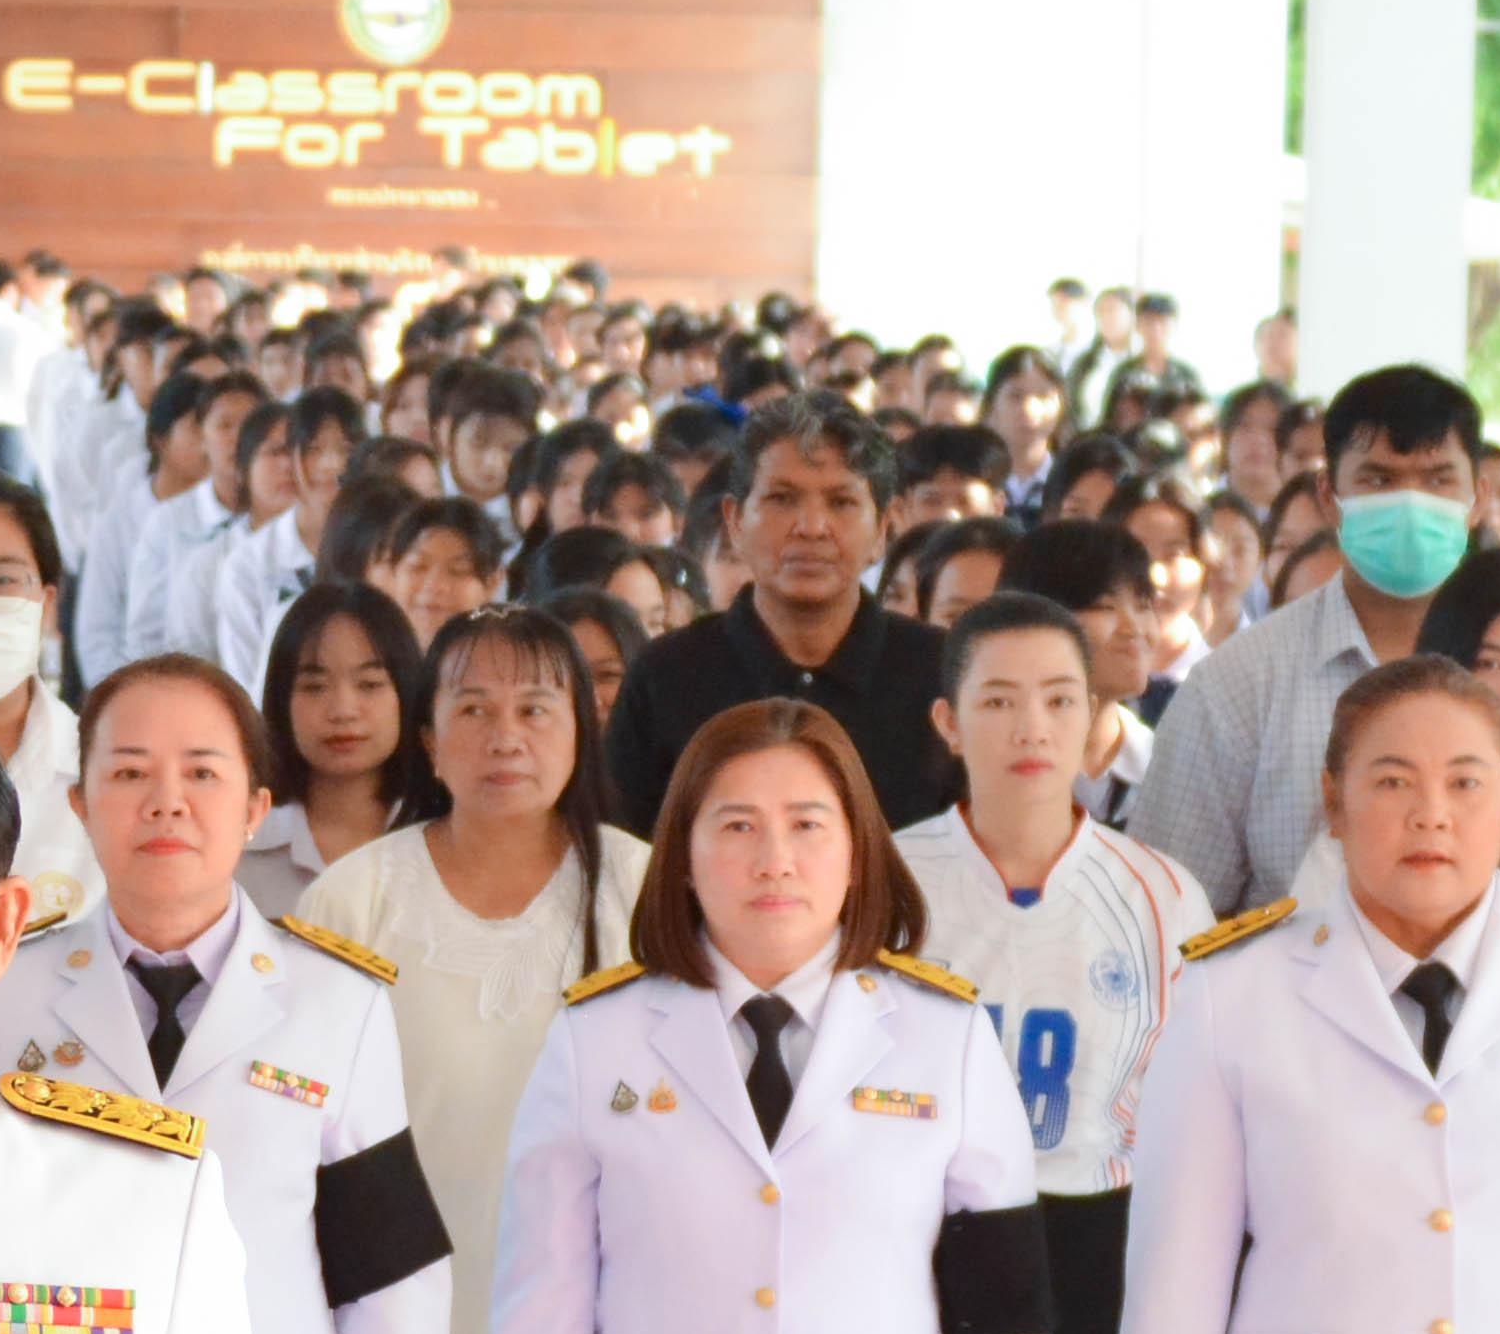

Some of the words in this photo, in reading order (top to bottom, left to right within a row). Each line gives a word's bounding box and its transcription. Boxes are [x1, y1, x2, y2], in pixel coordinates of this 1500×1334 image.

[4, 56, 603, 116] E-Classroom
[213, 116, 386, 168] For
[417, 116, 732, 178] Tablet
